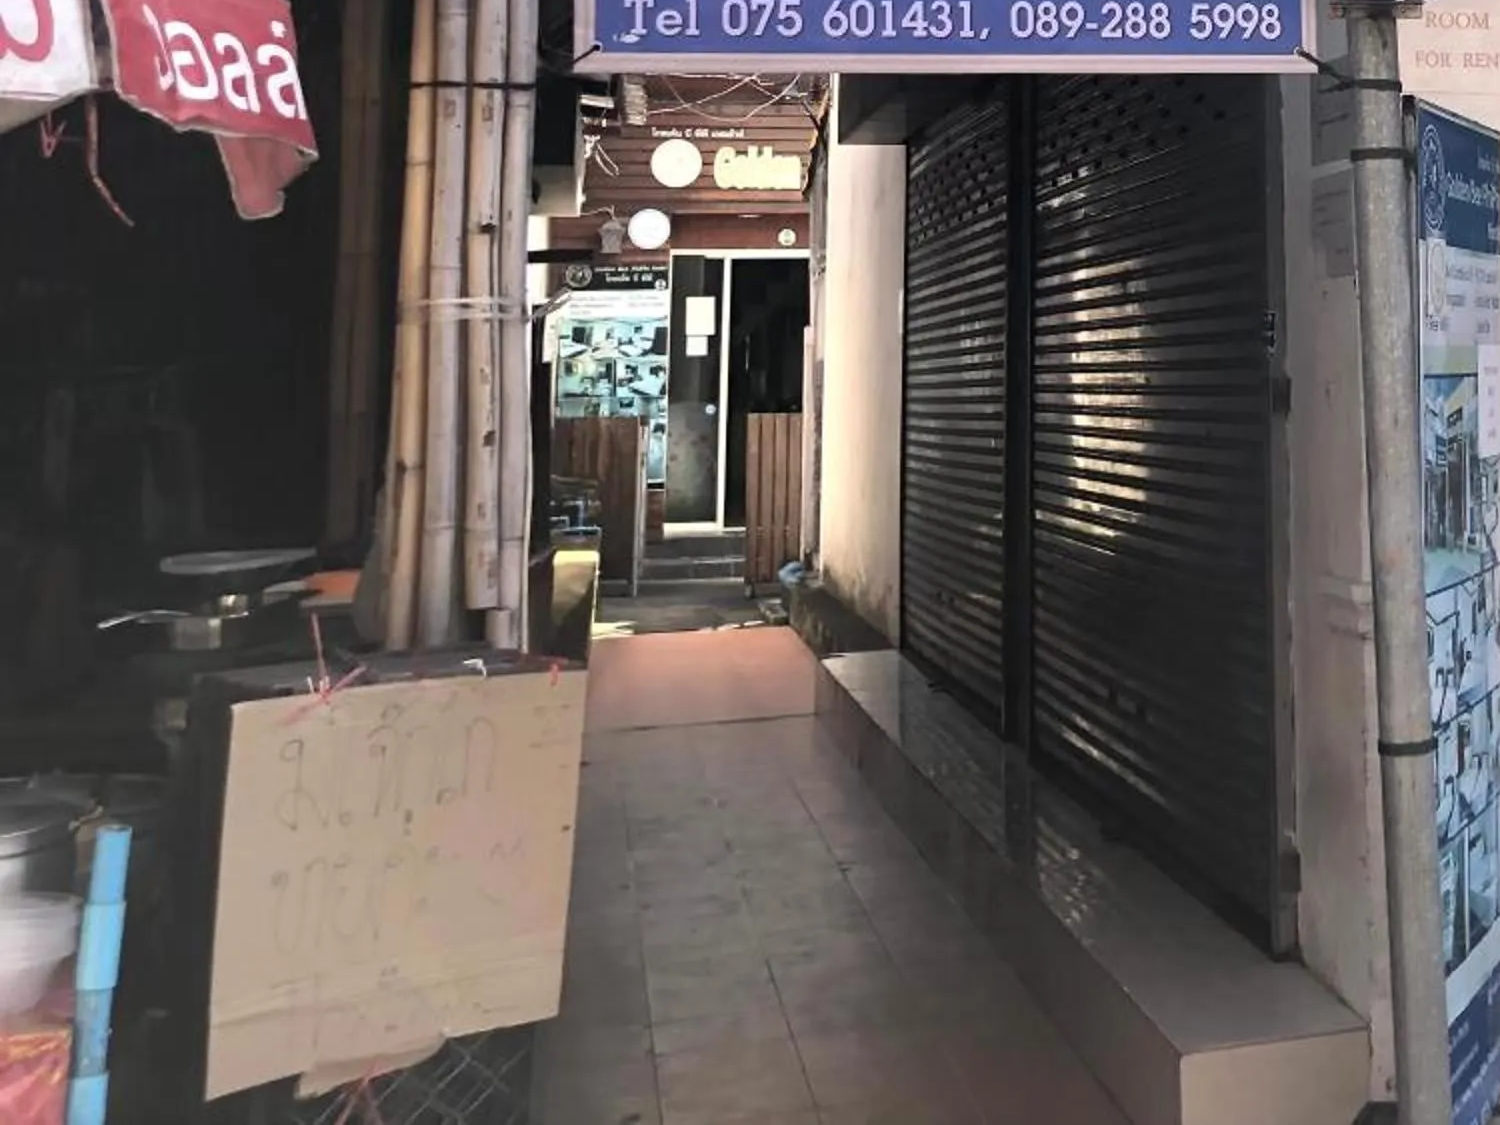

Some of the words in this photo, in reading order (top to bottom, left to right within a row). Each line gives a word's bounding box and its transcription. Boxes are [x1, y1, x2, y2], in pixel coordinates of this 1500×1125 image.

[822, 0, 991, 42] 601431,
[1009, 1, 1172, 40] 089-288
[1189, 1, 1283, 43] 5998
[1425, 11, 1490, 30] ROOM
[1414, 50, 1452, 69] FOR
